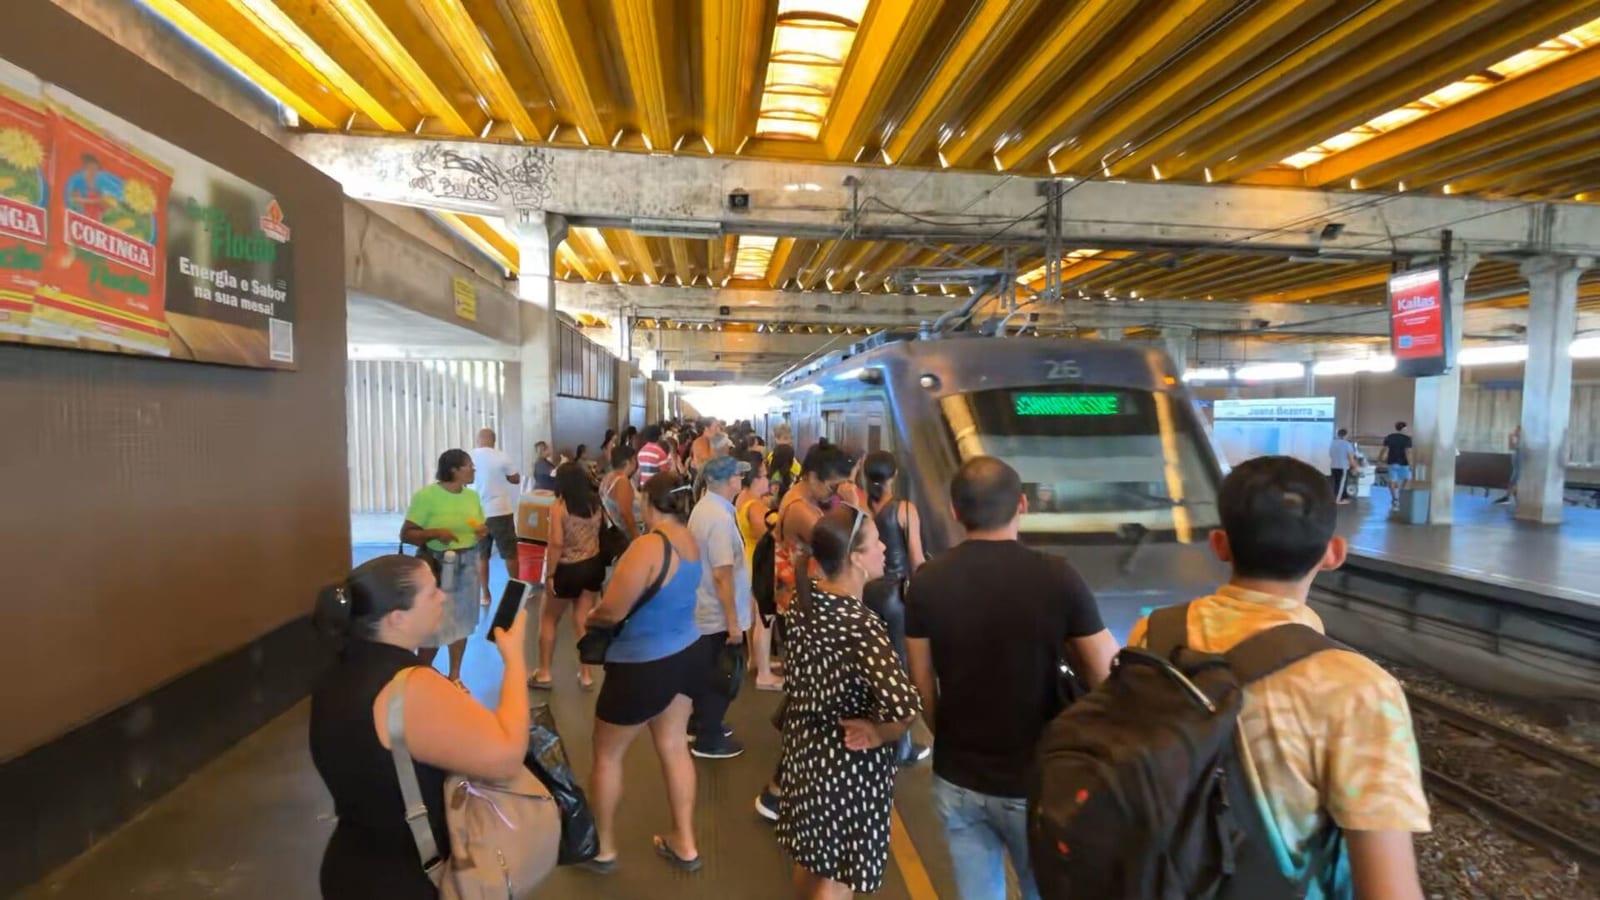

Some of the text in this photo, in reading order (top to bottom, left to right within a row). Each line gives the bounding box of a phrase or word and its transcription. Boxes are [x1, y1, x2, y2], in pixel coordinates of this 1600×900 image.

[71, 220, 151, 267] CORINGA
[179, 256, 237, 289] Energia
[240, 280, 249, 292] e
[251, 279, 286, 302] Sabor
[194, 284, 274, 316] na sua mesa!
[1397, 295, 1435, 311] Kallas
[1044, 359, 1082, 379] 26
